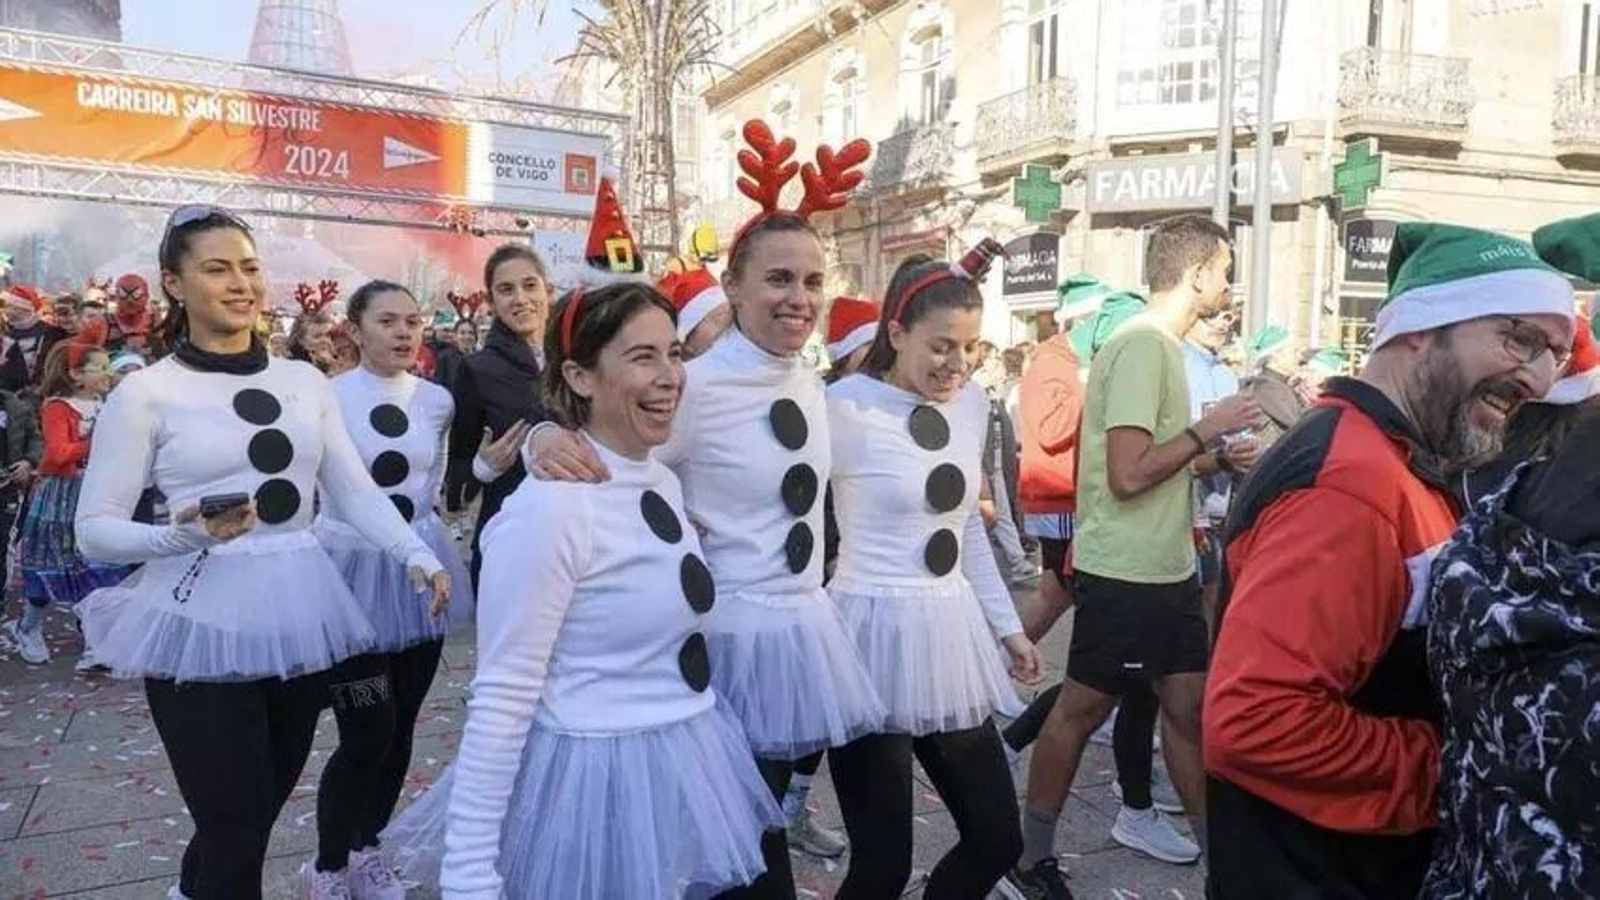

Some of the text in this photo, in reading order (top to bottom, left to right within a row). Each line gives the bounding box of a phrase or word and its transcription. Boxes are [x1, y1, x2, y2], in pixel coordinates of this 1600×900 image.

[77, 81, 322, 132] CARREIRA SAN SILVESTRE
[284, 144, 349, 178] 2024
[488, 151, 556, 171] CONCELLO
[495, 166, 549, 181] DE VIGO
